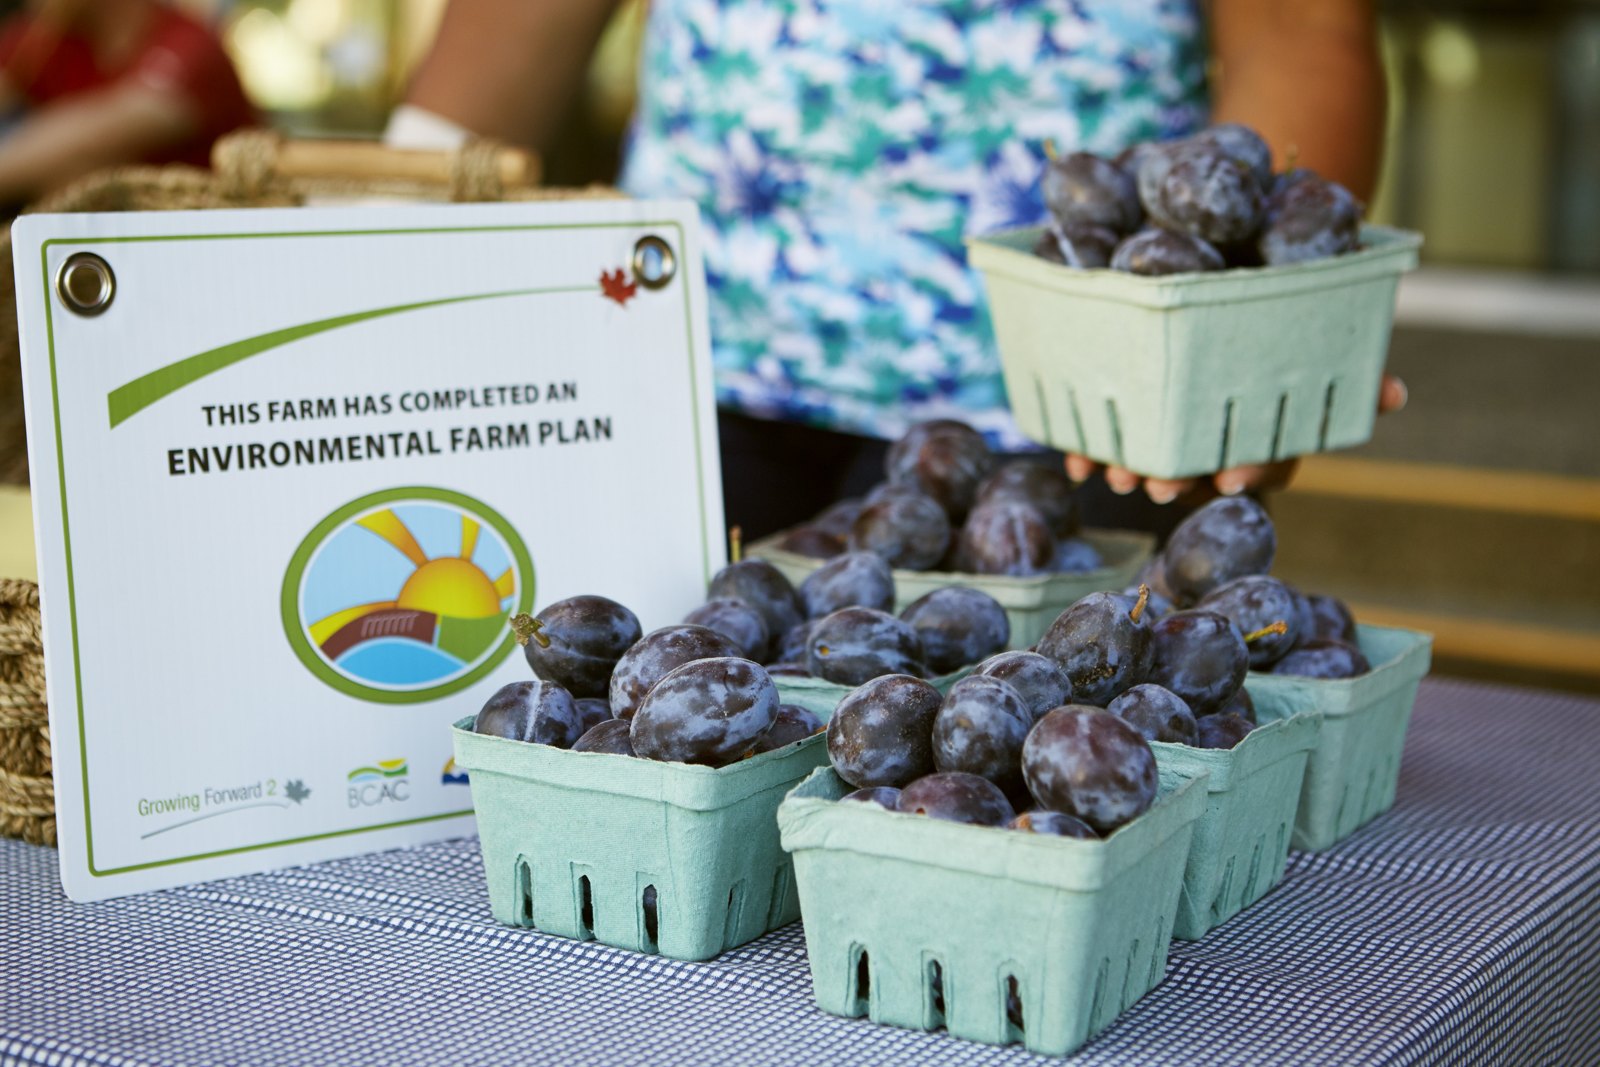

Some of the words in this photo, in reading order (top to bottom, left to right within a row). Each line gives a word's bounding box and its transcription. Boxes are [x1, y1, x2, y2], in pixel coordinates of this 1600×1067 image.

[202, 403, 260, 427] THIS
[268, 398, 337, 422] FARM
[344, 394, 393, 416] HAS
[400, 384, 540, 412] COMPLETED
[547, 381, 577, 402] AN
[168, 431, 442, 476] ENVIRONMENTAL
[450, 423, 530, 452] FARM
[539, 416, 613, 445] PLAN
[138, 793, 200, 816] Growing
[204, 781, 263, 805] Forward
[266, 779, 277, 796] 2
[347, 779, 411, 809] BCAC
